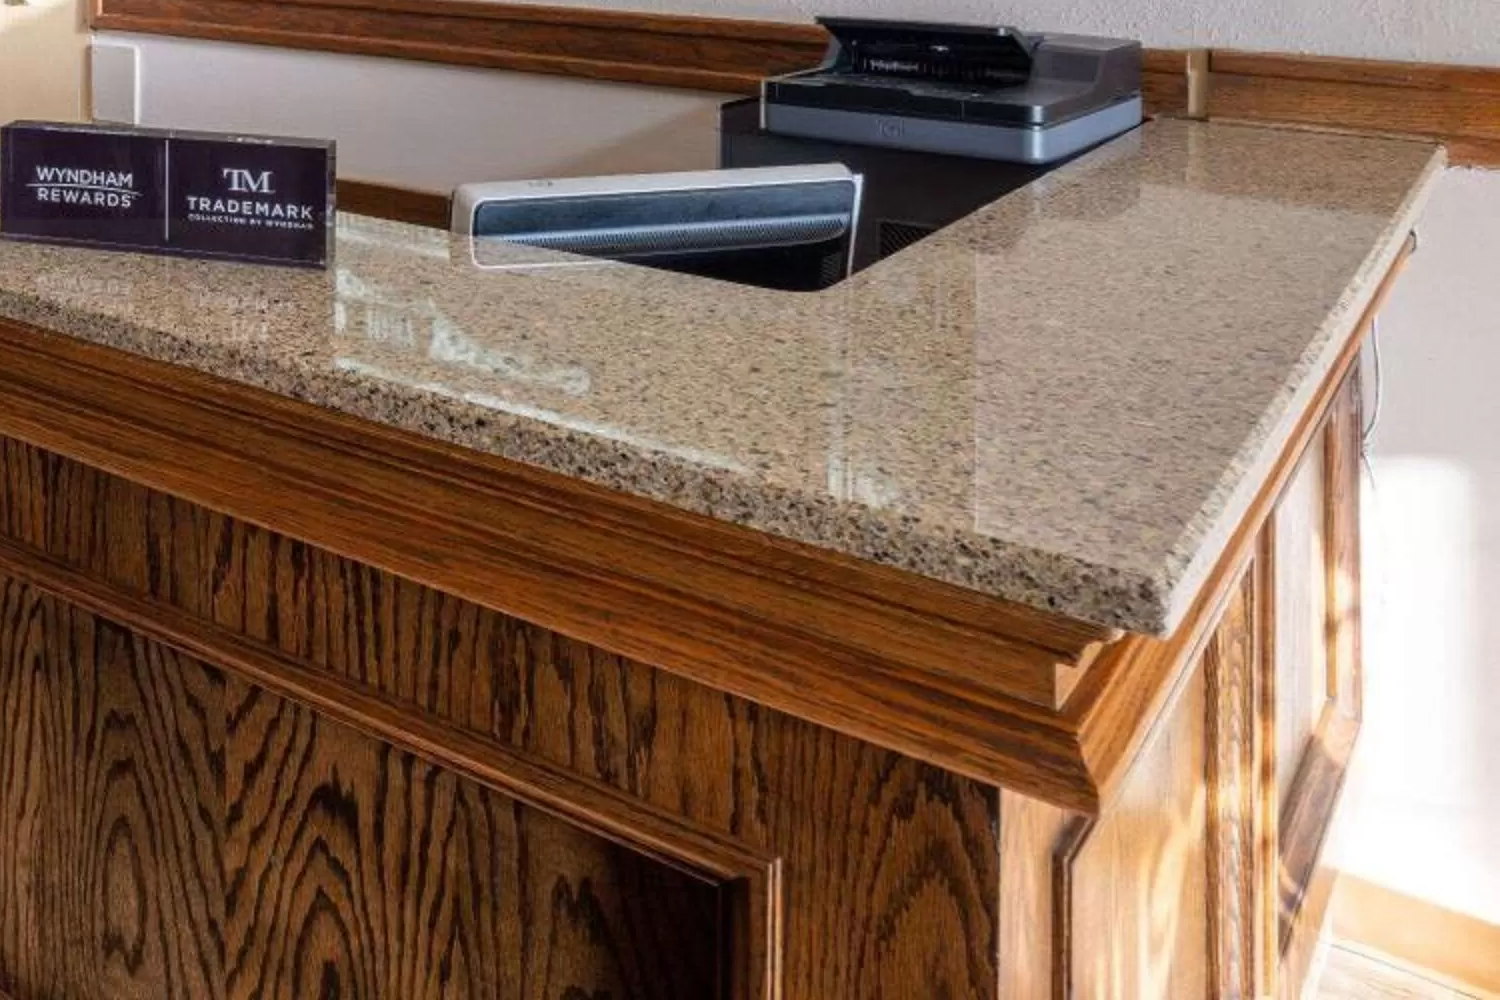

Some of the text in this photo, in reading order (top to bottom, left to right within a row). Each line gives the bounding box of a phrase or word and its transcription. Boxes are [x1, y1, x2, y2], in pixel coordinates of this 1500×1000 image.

[35, 164, 134, 189] WYNDHAM
[222, 167, 276, 195] TM
[37, 187, 133, 209] REWARDS
[187, 195, 314, 220] TRADEMARK
